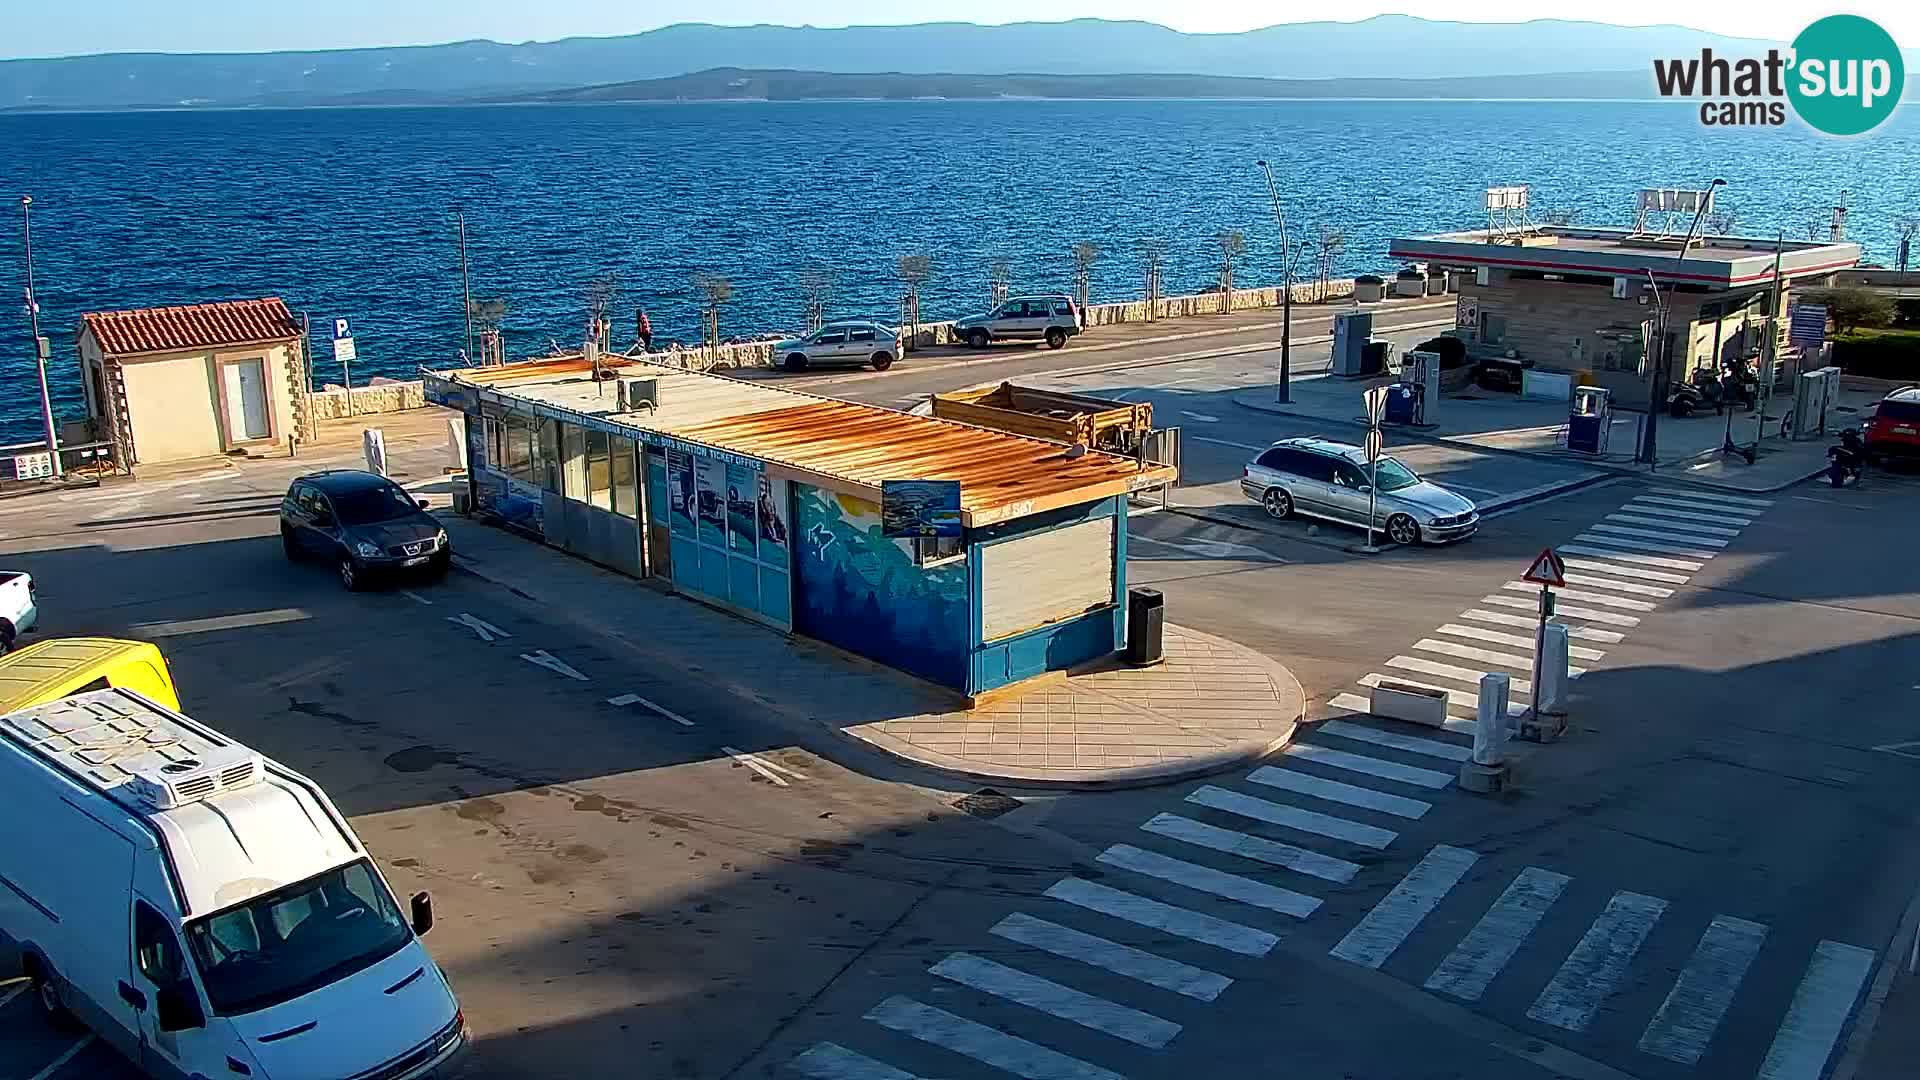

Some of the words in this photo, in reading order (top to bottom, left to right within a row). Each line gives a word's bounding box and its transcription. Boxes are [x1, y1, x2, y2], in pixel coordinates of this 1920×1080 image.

[676, 443, 706, 456] STATION
[709, 450, 733, 464] TICKET
[735, 456, 760, 469] OFFICE
